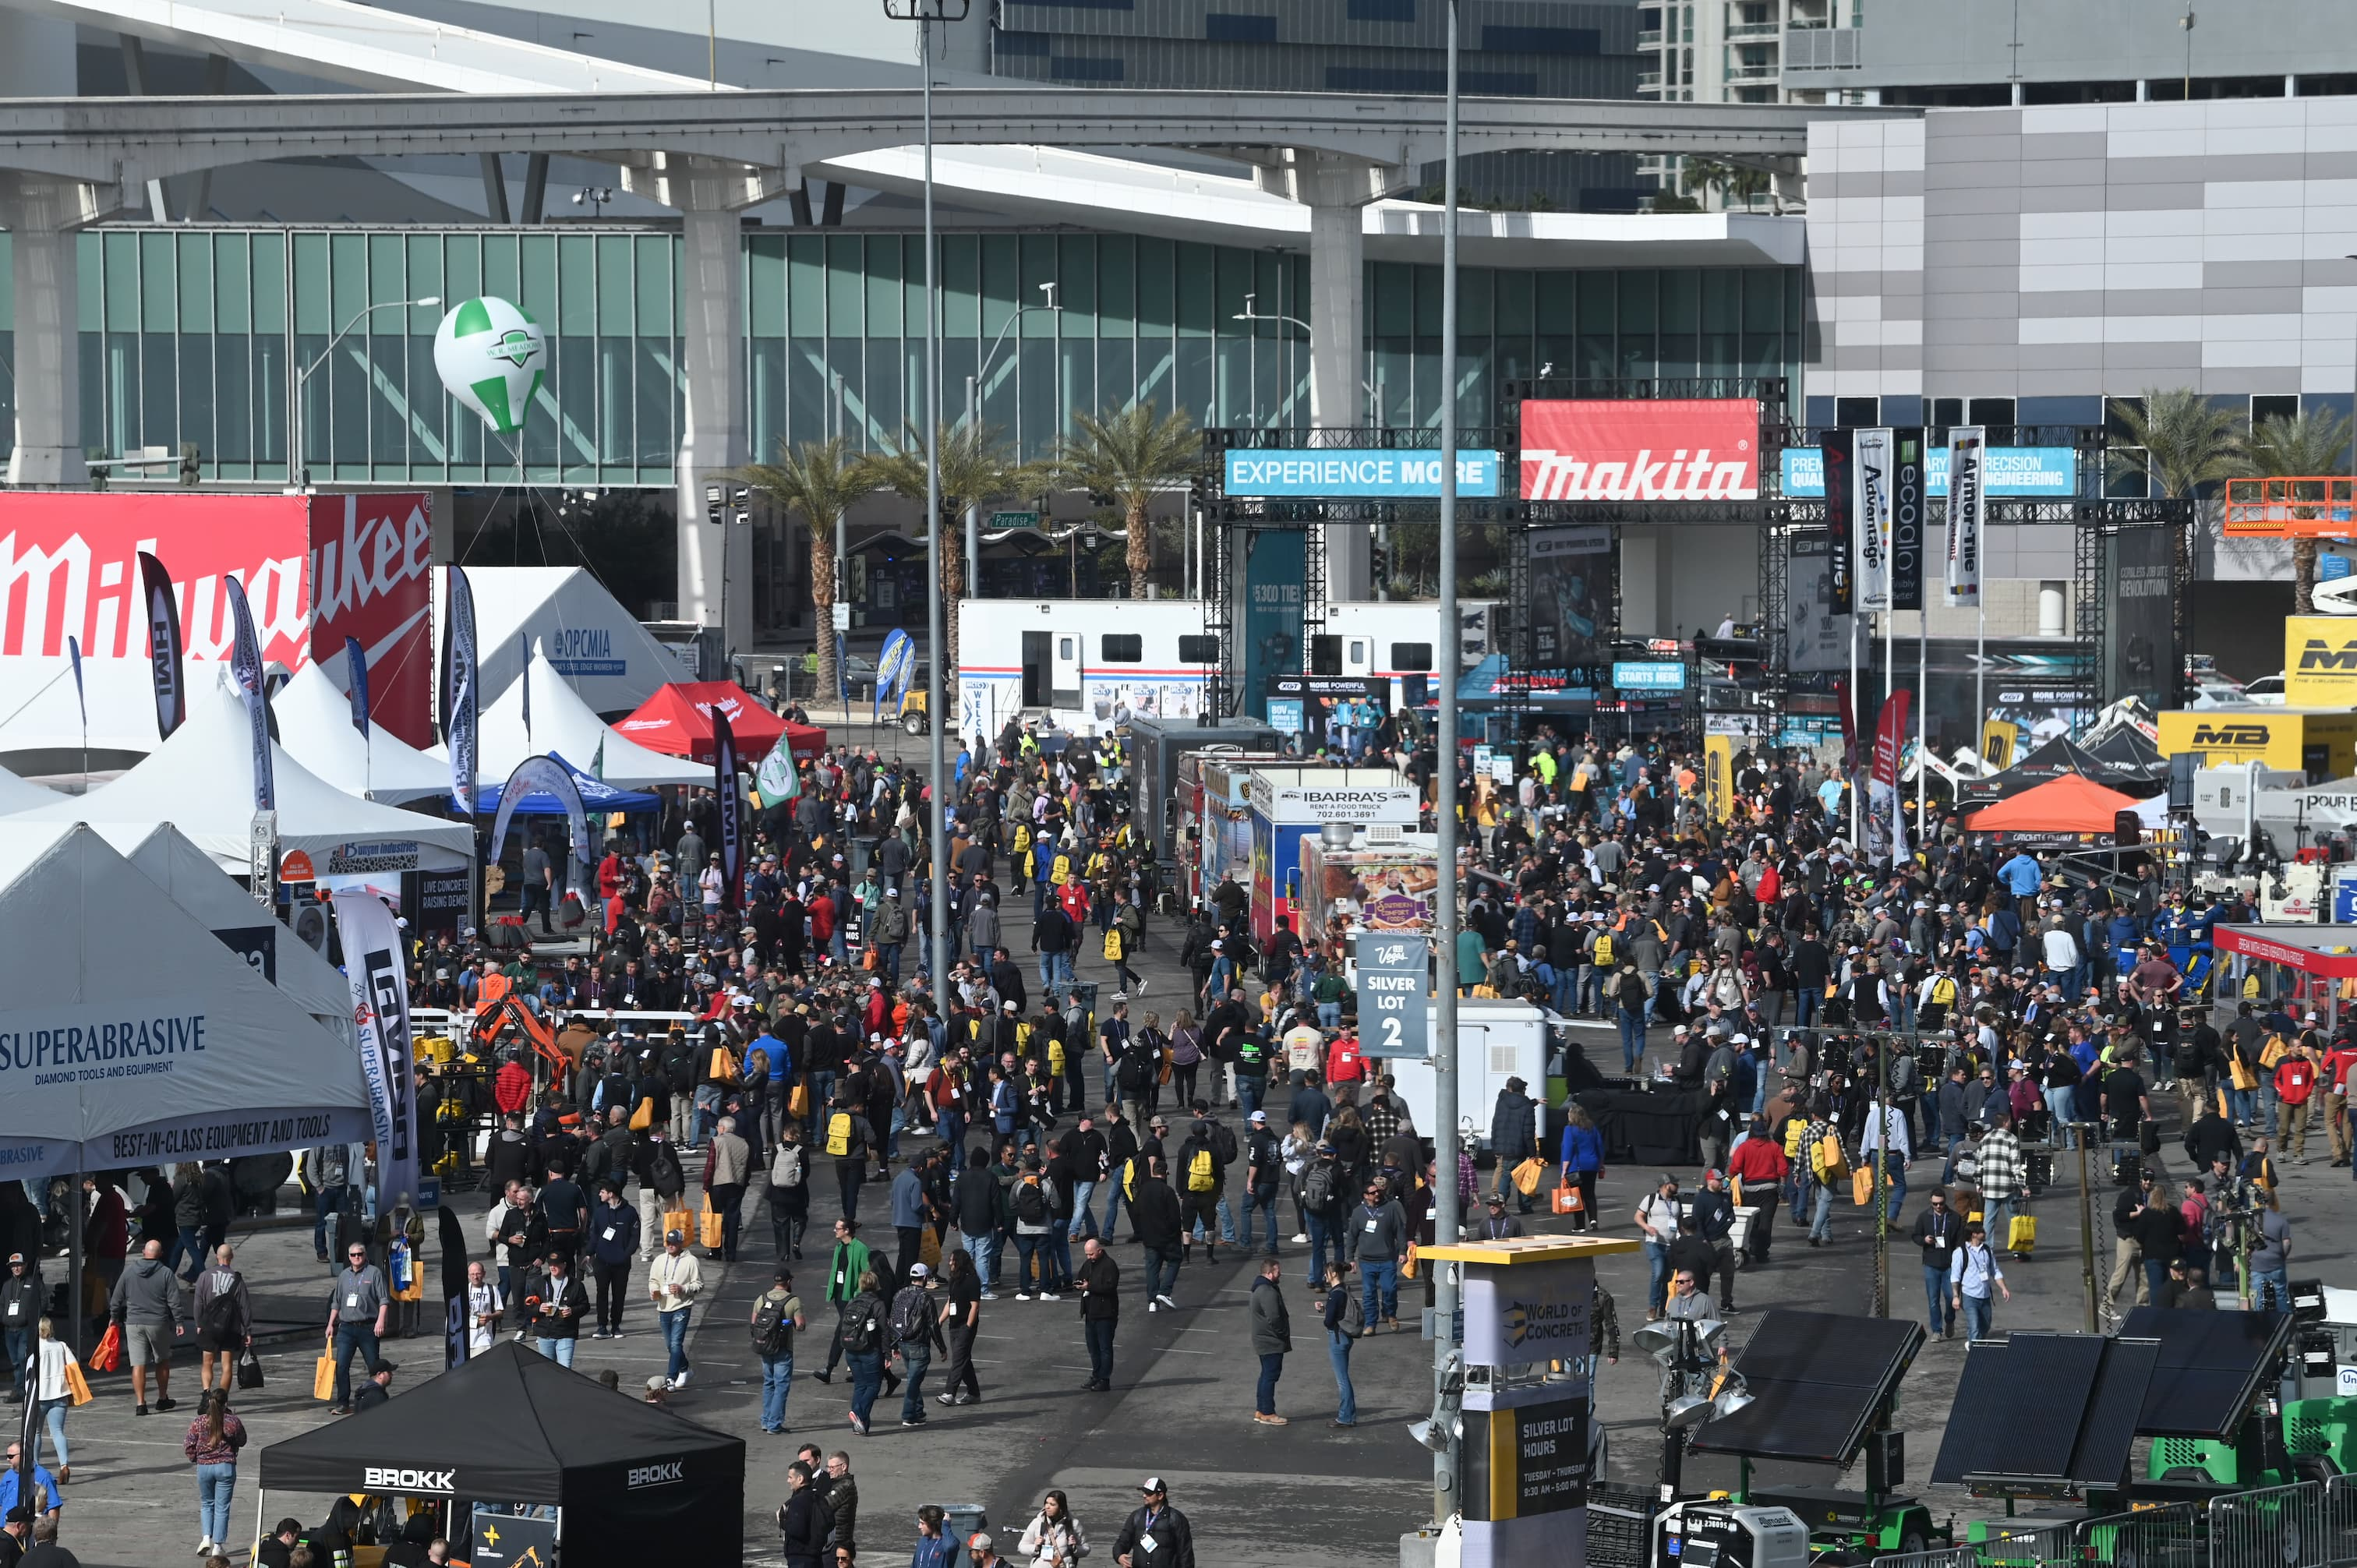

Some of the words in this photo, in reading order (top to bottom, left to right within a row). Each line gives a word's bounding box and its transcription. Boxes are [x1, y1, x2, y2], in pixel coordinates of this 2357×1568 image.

[1233, 461, 1394, 484] EXPERIENCE
[996, 514, 1028, 526] Paradise
[1863, 464, 1882, 569] Advantage
[1896, 465, 1920, 571] ecoglo
[1963, 457, 1977, 572] Armor-Tile
[1281, 585, 1301, 602] TIES
[2120, 578, 2168, 597] REVOLUTION
[564, 629, 610, 658] OPCMIA
[154, 620, 174, 696] HMI
[593, 663, 613, 672] WOMEN
[1617, 672, 1654, 683] STARTS
[1656, 672, 1680, 683] HERE
[2193, 725, 2270, 743] MB
[793, 749, 813, 758] HERE
[1304, 792, 1387, 802] IBARRA'S
[2307, 795, 2346, 811] POUR
[724, 774, 735, 846] HMI
[345, 842, 379, 858] Bunyan
[379, 841, 418, 853] Industries
[423, 879, 436, 893] LIVE
[437, 878, 468, 892] CONCRETE
[423, 895, 447, 909] RAISING
[448, 894, 468, 907] DEMOS
[1368, 976, 1415, 991] SILVER
[1377, 996, 1405, 1010] LOT
[1381, 1017, 1403, 1047] 2
[0, 1015, 205, 1071] SUPERABRASIVE
[364, 948, 408, 1161] LAVINA
[35, 1070, 76, 1085] DIAMOND
[78, 1068, 104, 1081] TOOLS
[106, 1065, 125, 1079] AND
[126, 1061, 174, 1075] EQUIPMENT
[359, 1028, 389, 1148] SUPERABRASIVE
[113, 1128, 203, 1159] BEST-IN-CLASS
[205, 1121, 270, 1150] EQUIPMENT
[270, 1119, 293, 1142] AND
[296, 1114, 330, 1139] TOOLS
[1525, 1304, 1568, 1322] WORLD
[1571, 1305, 1583, 1317] OF
[1525, 1321, 1584, 1340] CONCRETE
[1523, 1419, 1557, 1439] SILVER
[1558, 1417, 1574, 1432] LOT
[1524, 1440, 1557, 1459] HOURS
[364, 1468, 453, 1490] BROKK
[627, 1461, 683, 1486] BROKK
[1524, 1469, 1552, 1484] TUESDAY
[1557, 1464, 1586, 1478] THURSDAY
[1524, 1487, 1539, 1498] 9:30
[1540, 1484, 1550, 1495] AM
[1556, 1481, 1569, 1492] 5:00
[1570, 1479, 1579, 1490] PM
